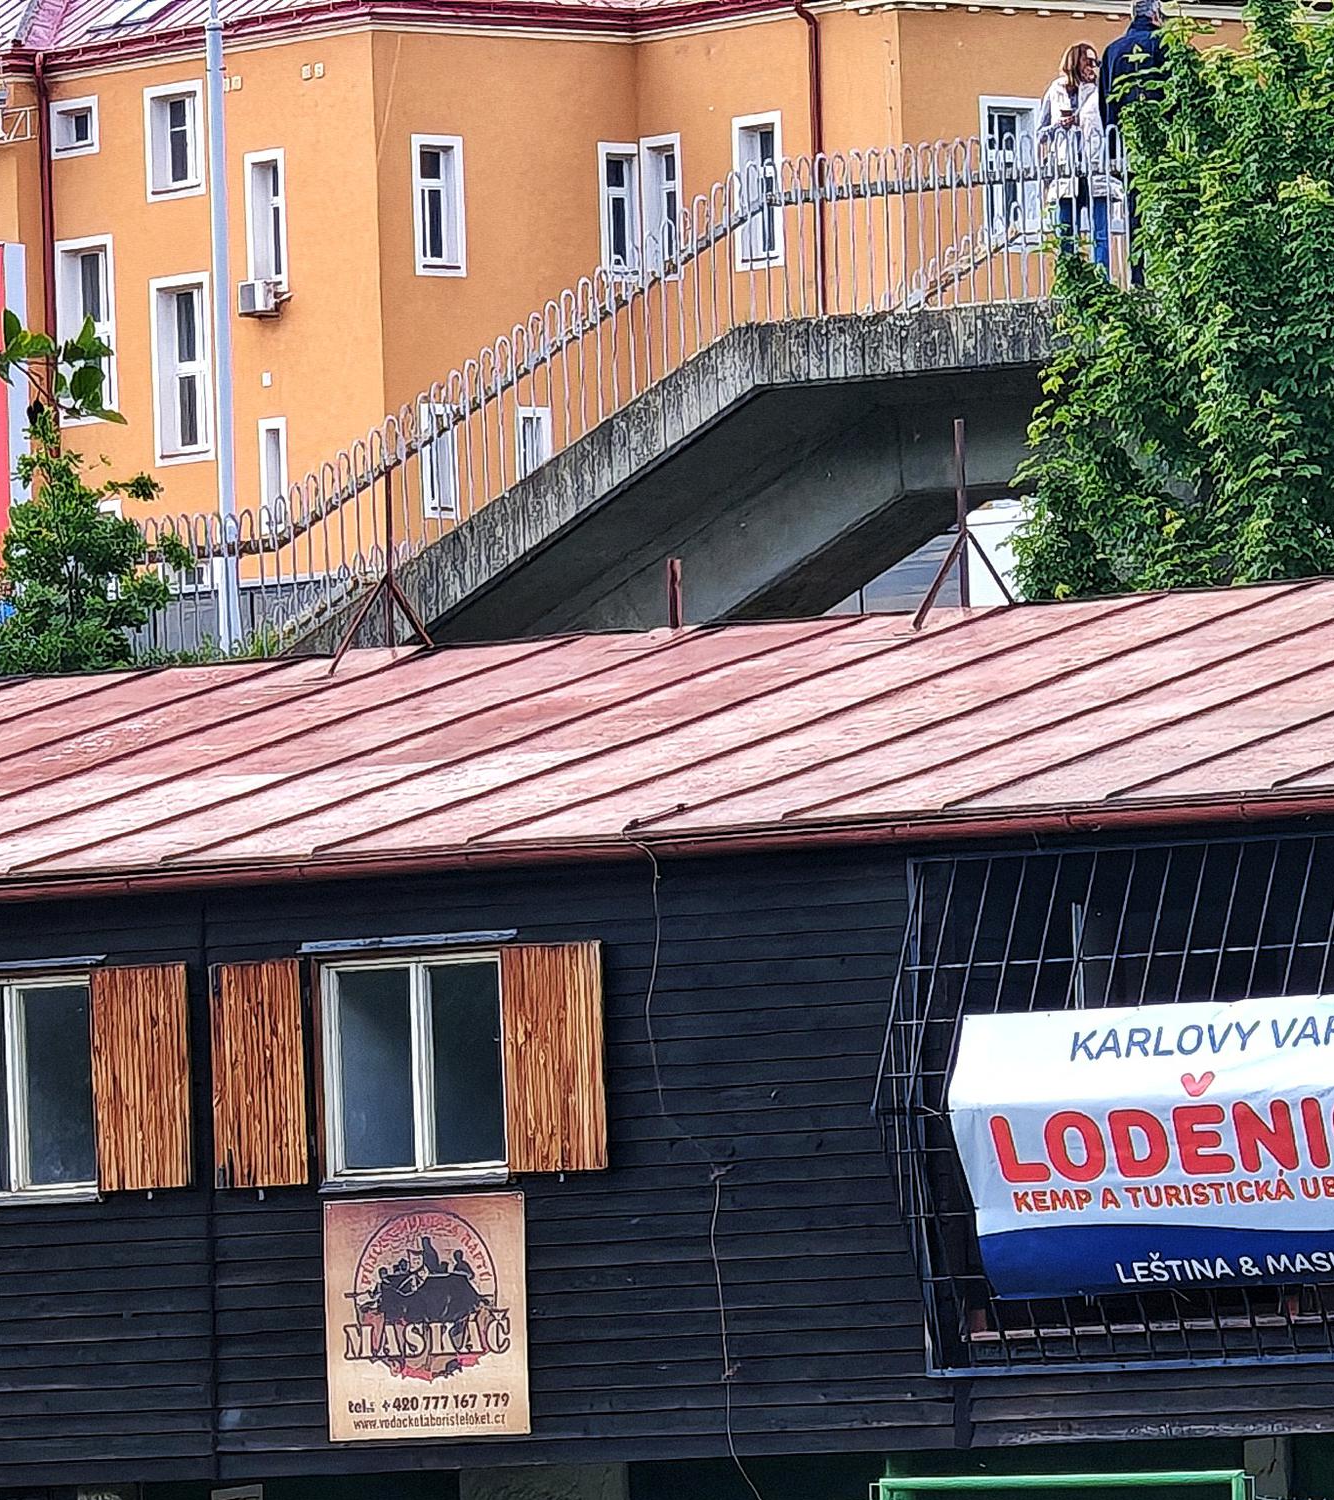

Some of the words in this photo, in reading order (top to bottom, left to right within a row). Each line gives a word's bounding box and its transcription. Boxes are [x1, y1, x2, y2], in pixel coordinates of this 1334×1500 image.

[1069, 1020, 1261, 1062] KARLOVY
[1013, 1187, 1092, 1213] KEMP
[1100, 1187, 1122, 1210] A
[1124, 1170, 1296, 1209] TURISTICKÁ
[1115, 1252, 1236, 1284] LEŠTINA
[1239, 1256, 1263, 1277] &
[344, 1308, 510, 1360] MASKÁČ
[422, 1396, 449, 1411] 777
[453, 1394, 478, 1409] 167
[482, 1393, 510, 1408] 779
